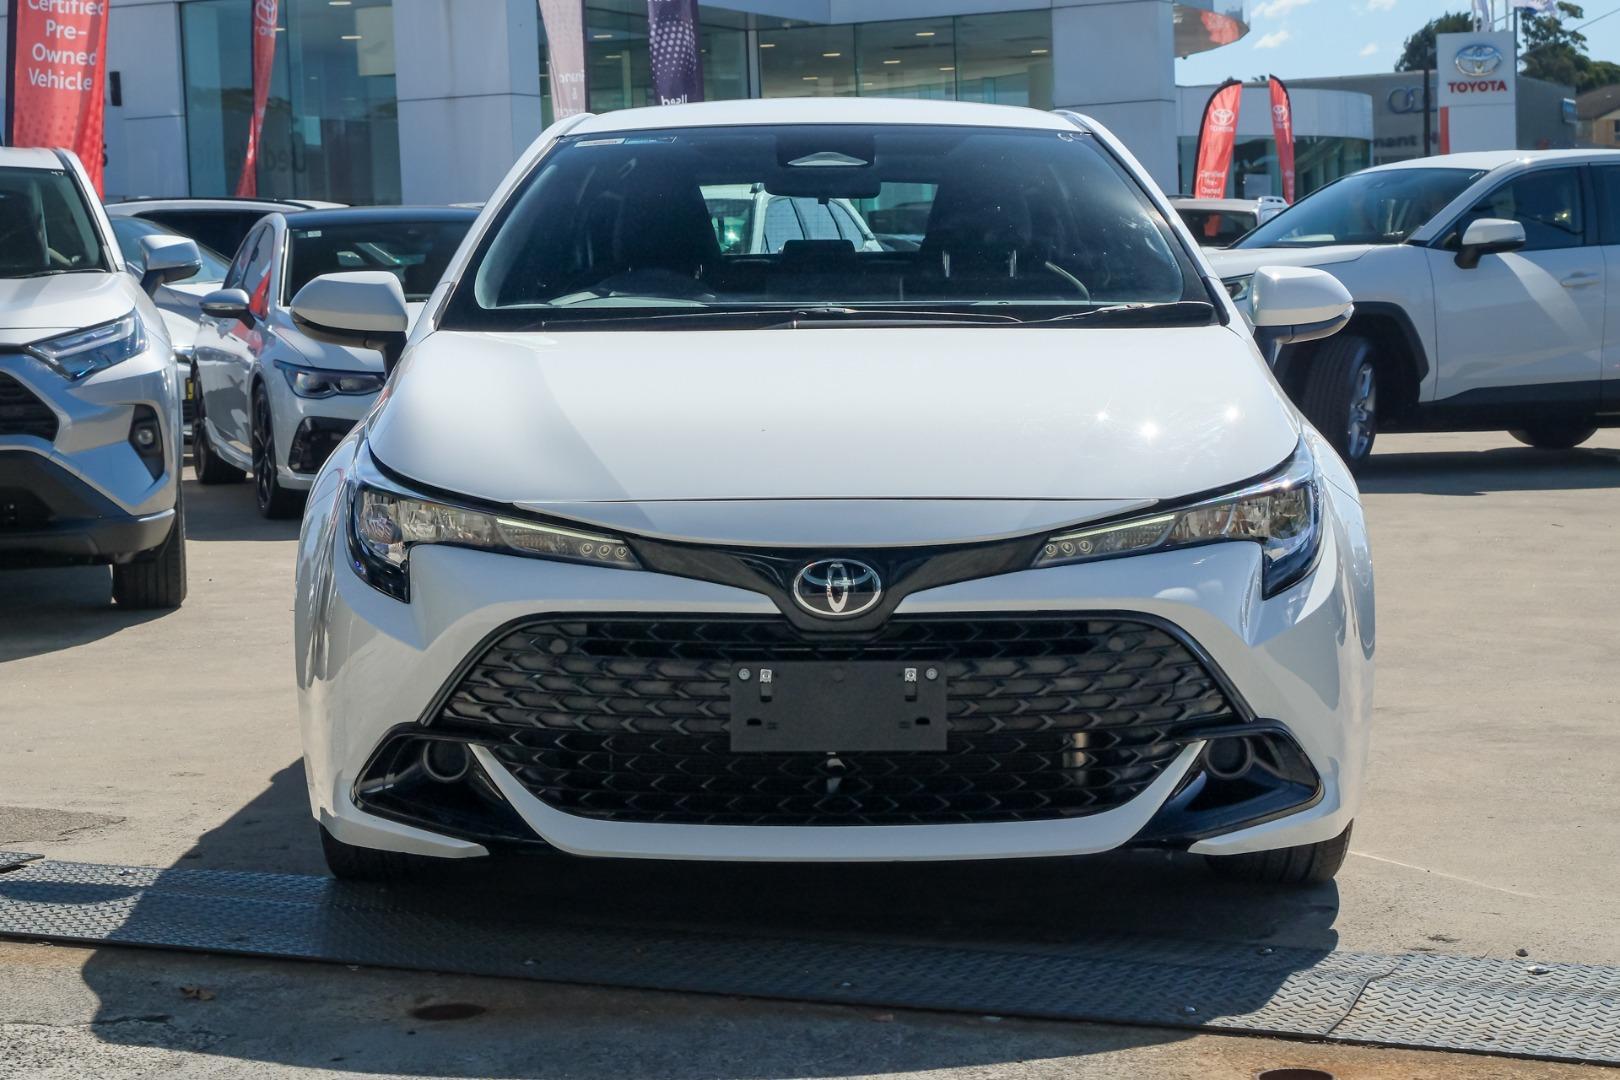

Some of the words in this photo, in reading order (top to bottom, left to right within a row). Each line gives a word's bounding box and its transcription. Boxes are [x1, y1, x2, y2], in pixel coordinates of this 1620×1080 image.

[46, 19, 87, 39] Pre-
[28, 67, 92, 91] Vehicle
[1448, 80, 1507, 93] TOYOTA
